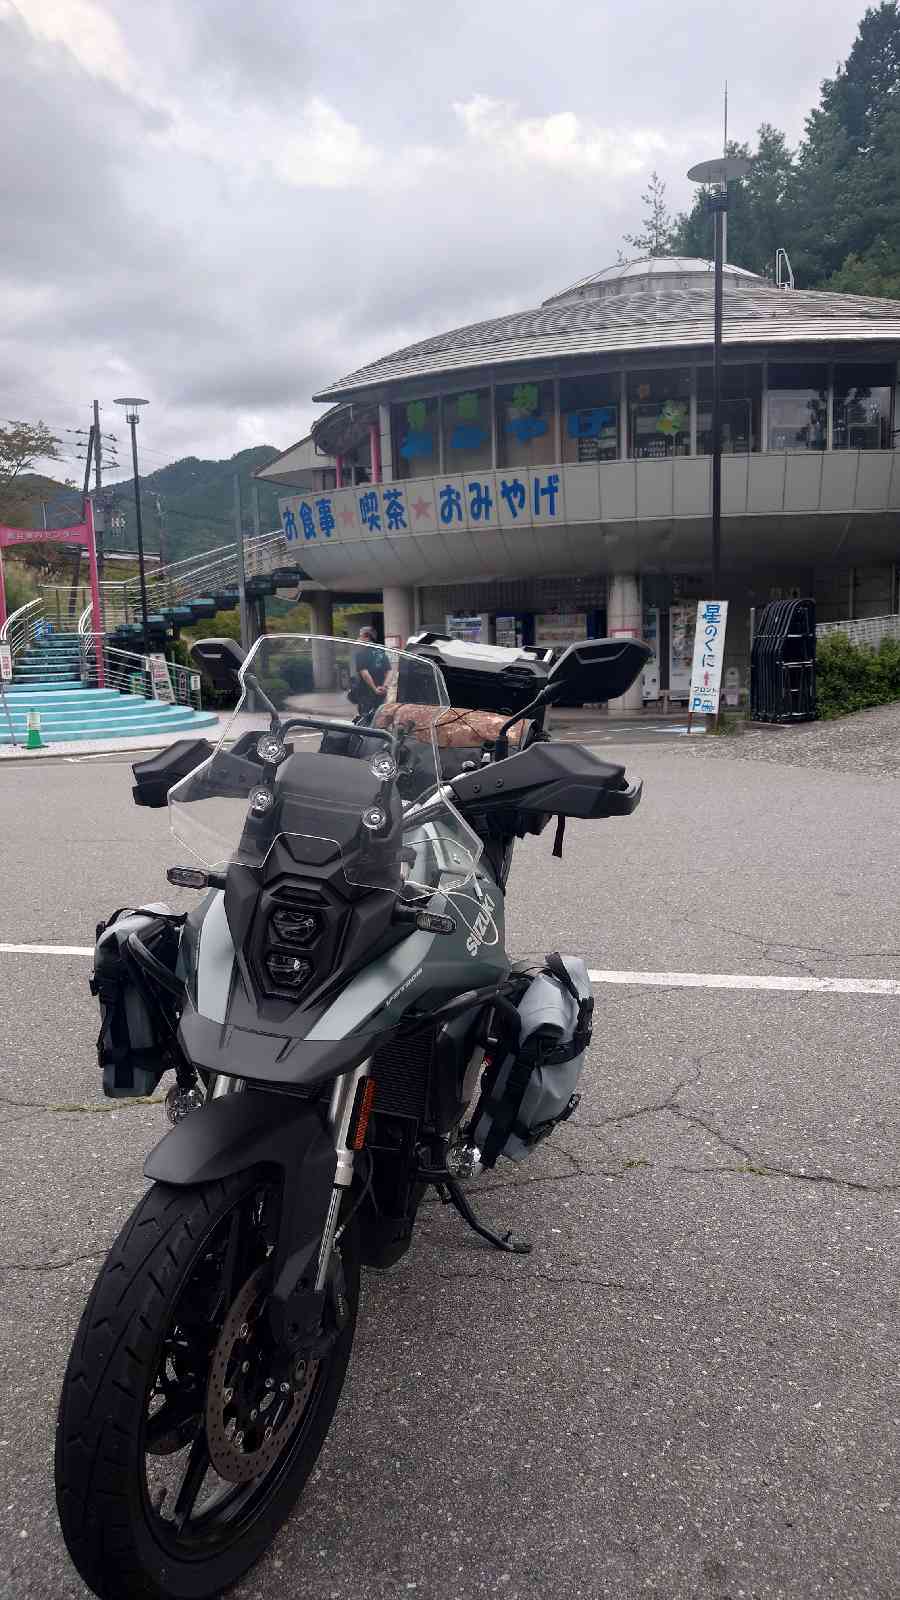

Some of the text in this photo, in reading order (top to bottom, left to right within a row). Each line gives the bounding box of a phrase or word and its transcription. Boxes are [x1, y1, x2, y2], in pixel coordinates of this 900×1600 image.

[282, 473, 560, 542] お食事 喫茶 おみやげ
[702, 604, 721, 667] 星のくに
[466, 893, 496, 957] SUZUKI
